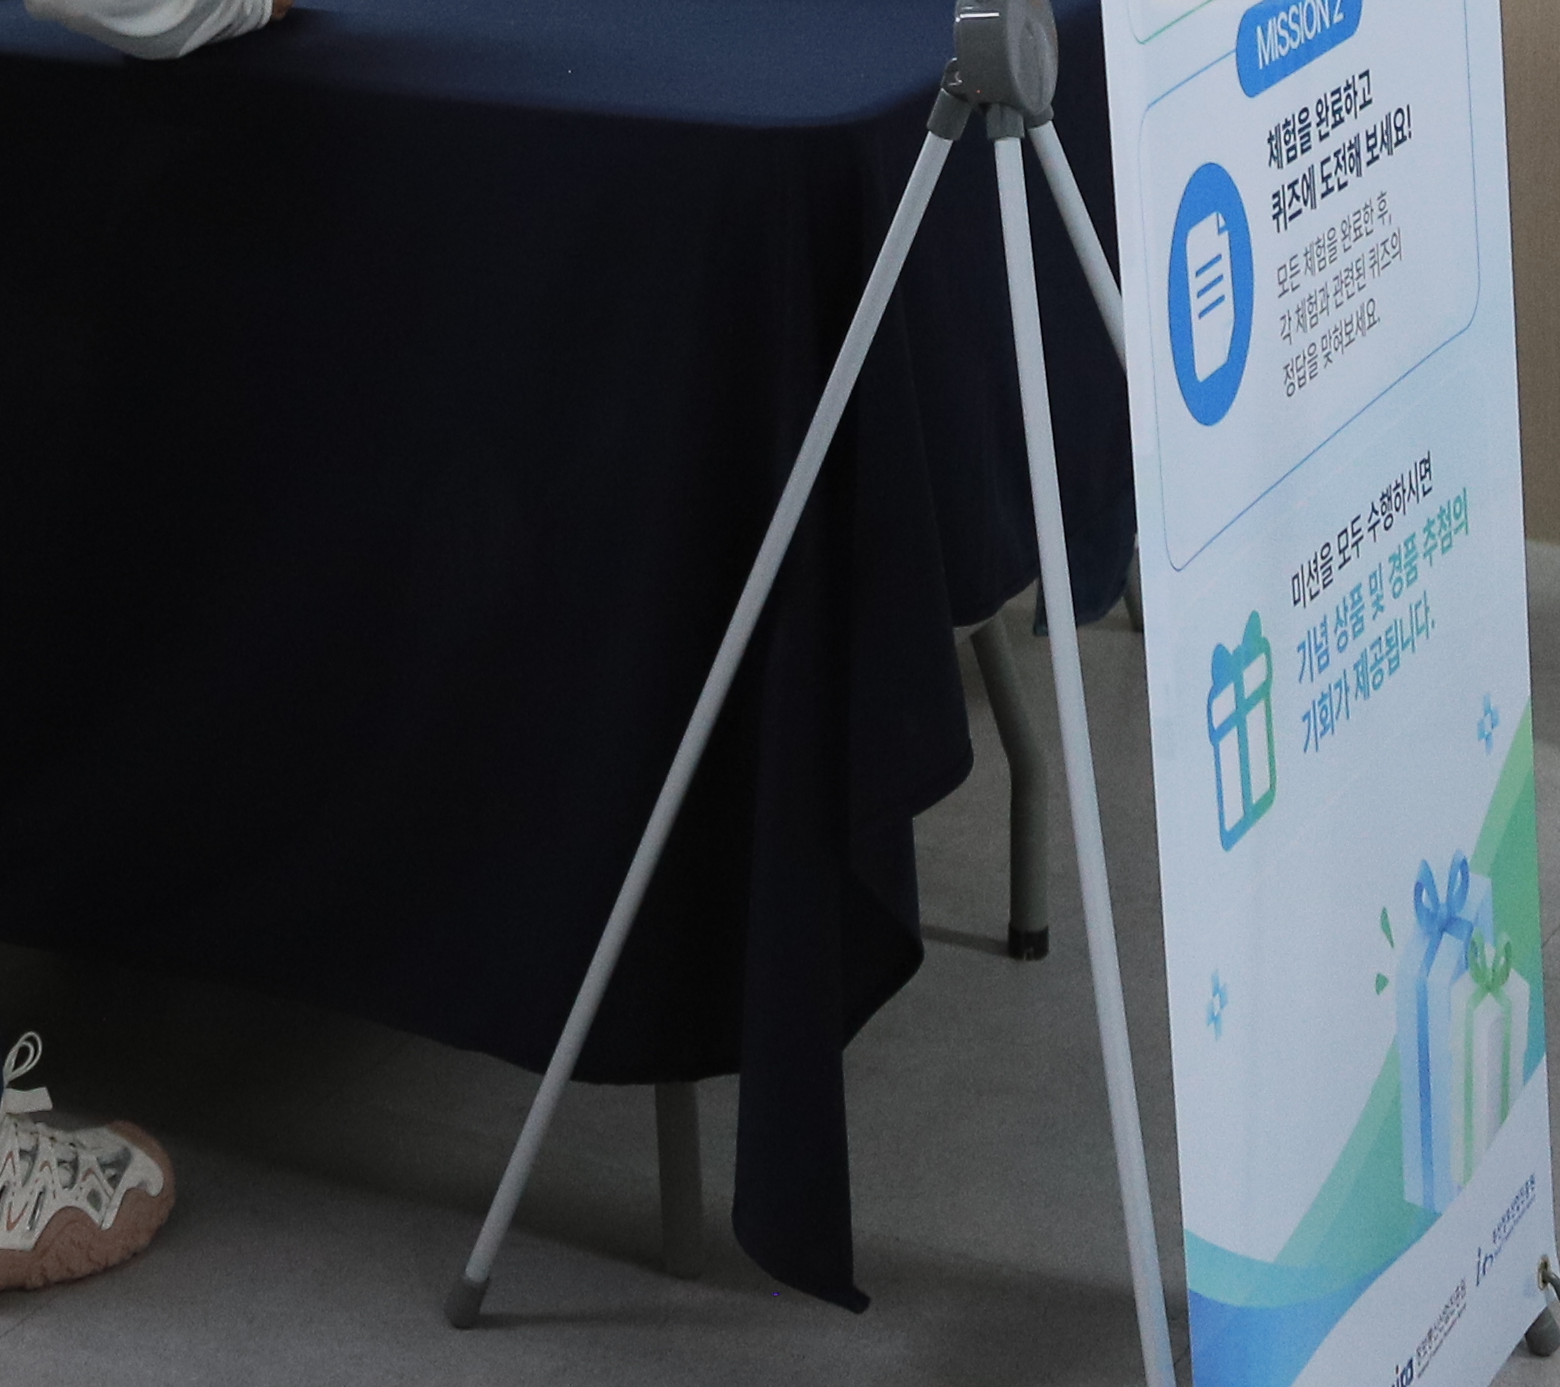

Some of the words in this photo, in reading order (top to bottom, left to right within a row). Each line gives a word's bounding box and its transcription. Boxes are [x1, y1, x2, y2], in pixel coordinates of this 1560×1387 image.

[1291, 541, 1334, 609] 미션을
[1337, 516, 1365, 572] 모두
[1366, 450, 1432, 544] 수행하시면
[1297, 614, 1330, 684] 기념
[1333, 585, 1365, 652] 상품
[1368, 561, 1386, 618] 및
[1388, 533, 1419, 599] 경품
[1422, 487, 1470, 567] 추첨의
[1301, 669, 1351, 754] 기회가
[1353, 590, 1437, 702] 제공됩니다.
